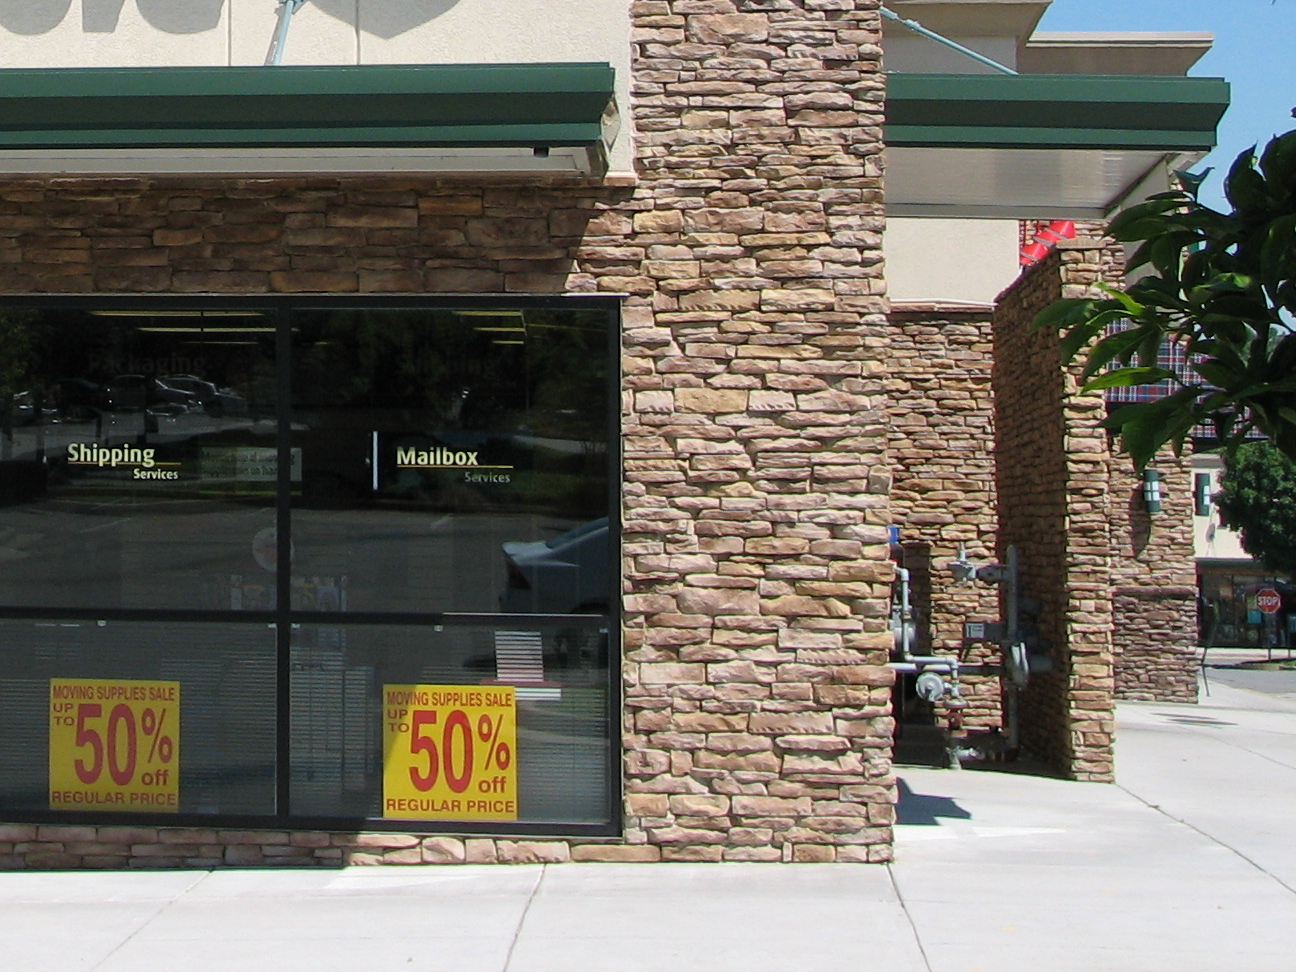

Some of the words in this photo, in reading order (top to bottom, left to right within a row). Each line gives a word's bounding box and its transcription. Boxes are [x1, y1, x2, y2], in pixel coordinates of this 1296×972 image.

[67, 443, 156, 468] Shipping
[396, 446, 479, 466] Mailbox
[133, 468, 179, 480] Services
[464, 471, 511, 483] Services
[1257, 596, 1279, 606] STOP
[53, 685, 94, 700] MOVING
[97, 686, 146, 701] SUPPLIES
[148, 687, 175, 701] SALE
[387, 691, 429, 706] MOVING
[431, 692, 482, 707] SUPPLIES
[485, 693, 512, 707] SALE
[53, 703, 74, 713] UP
[387, 709, 408, 719] UP
[54, 716, 75, 726] TO
[387, 722, 410, 733] TO
[74, 703, 173, 786] 50%
[409, 710, 511, 794] 50%
[141, 769, 169, 786] off
[478, 776, 507, 794] off
[52, 791, 124, 804] REGULAR
[130, 792, 177, 806] PRICE
[386, 798, 462, 812] REGULAR
[467, 800, 514, 813] PRICE
